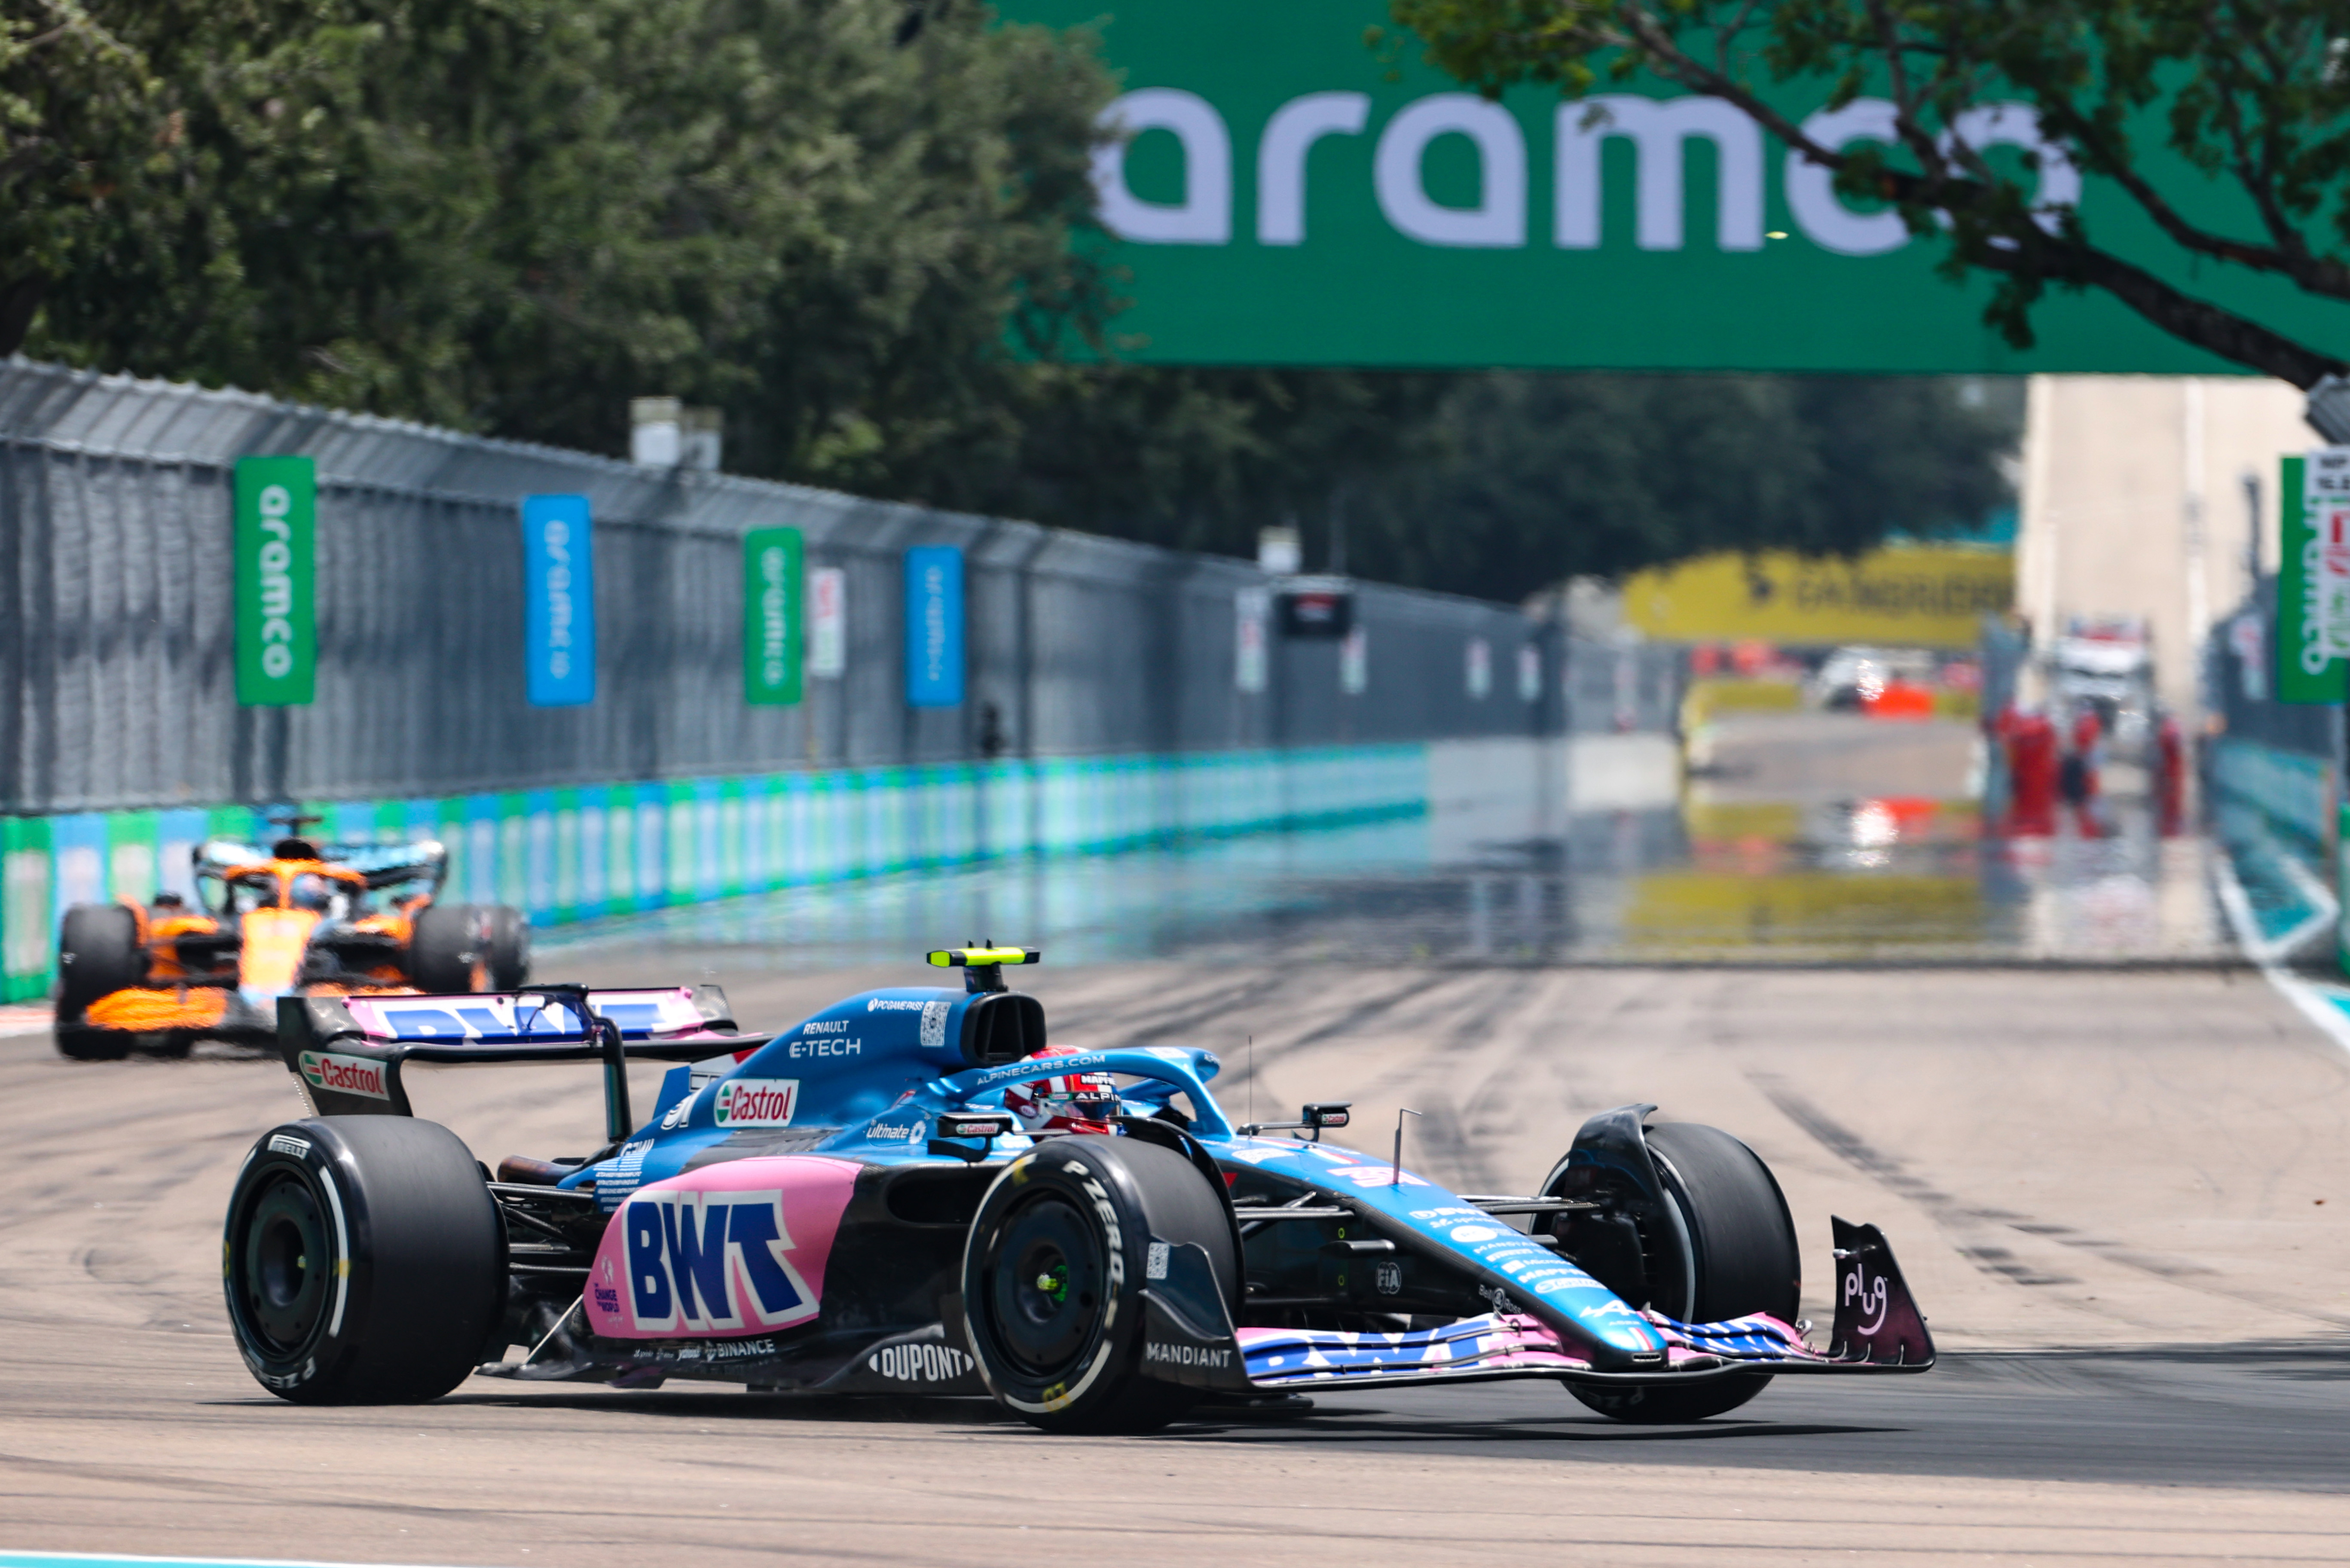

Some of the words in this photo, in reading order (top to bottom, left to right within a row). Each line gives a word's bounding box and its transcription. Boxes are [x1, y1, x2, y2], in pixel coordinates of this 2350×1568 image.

[259, 484, 292, 678] aramco
[803, 1020, 849, 1035] RENAULT
[789, 1038, 861, 1058] E-TECH
[321, 1058, 384, 1094] Castrol
[977, 1055, 1106, 1086] ALPINECARS.COM
[731, 1085, 791, 1120] Castrol
[867, 1122, 910, 1138] ultimate
[967, 1123, 996, 1133] Castrol
[267, 1134, 311, 1160] PIRELLI
[627, 1202, 804, 1320] BWT
[1378, 1268, 1400, 1287] FIA
[1845, 1263, 1887, 1335] plug
[718, 1339, 775, 1358] BINANCE
[1146, 1342, 1232, 1368] MANDIANT
[882, 1344, 961, 1382] DUPONT
